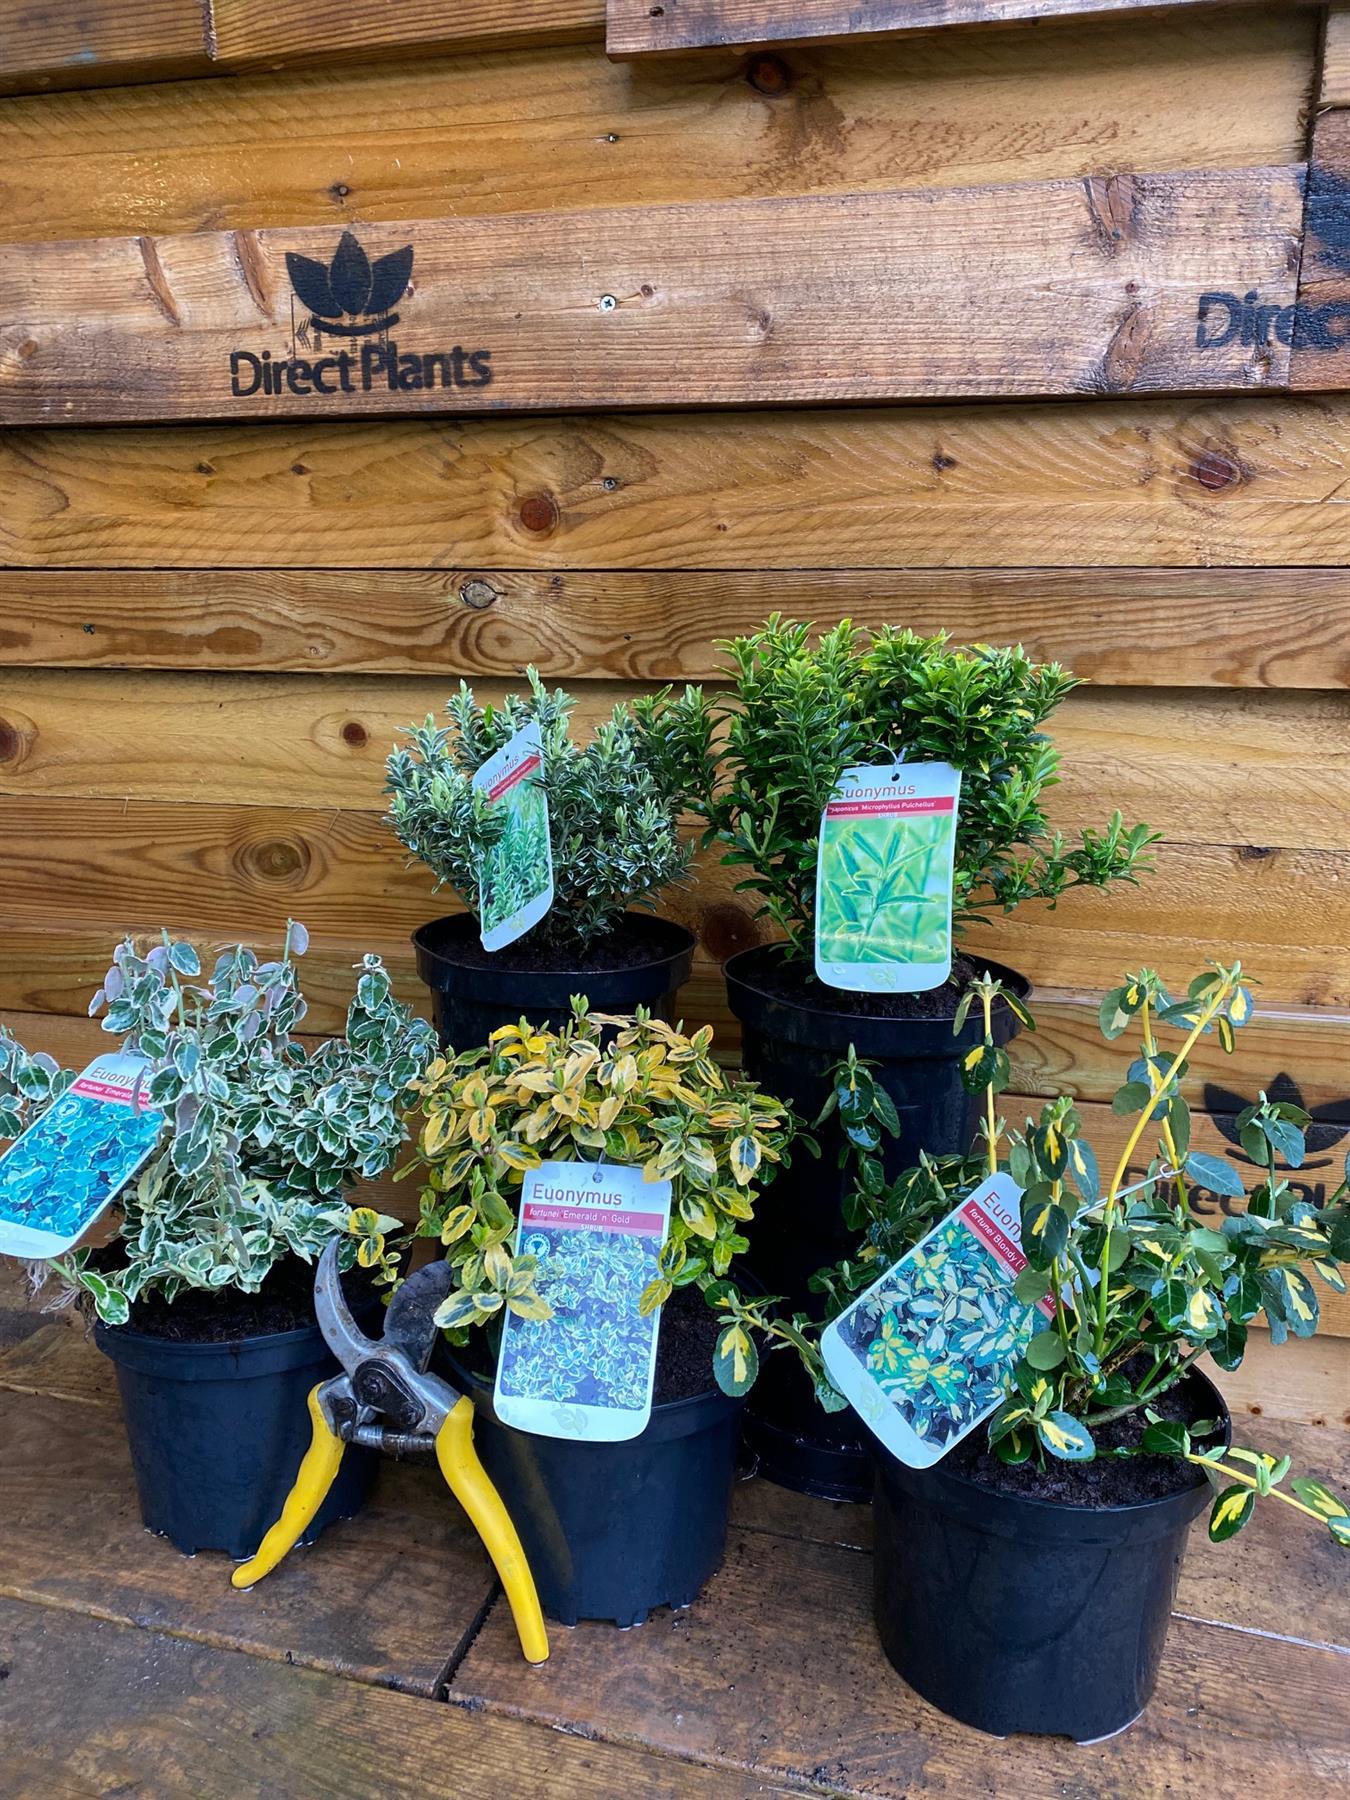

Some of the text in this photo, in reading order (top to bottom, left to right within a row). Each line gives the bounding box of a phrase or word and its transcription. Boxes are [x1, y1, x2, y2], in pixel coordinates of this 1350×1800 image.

[482, 755, 519, 789] uonymus
[842, 785, 916, 799] uonymus
[532, 1183, 622, 1206] Euonymus
[529, 1207, 559, 1218] fortunei
[983, 1191, 1022, 1243] Euon
[580, 1223, 603, 1232] SHRUB
[969, 1208, 1018, 1263] fortunei Blondy
